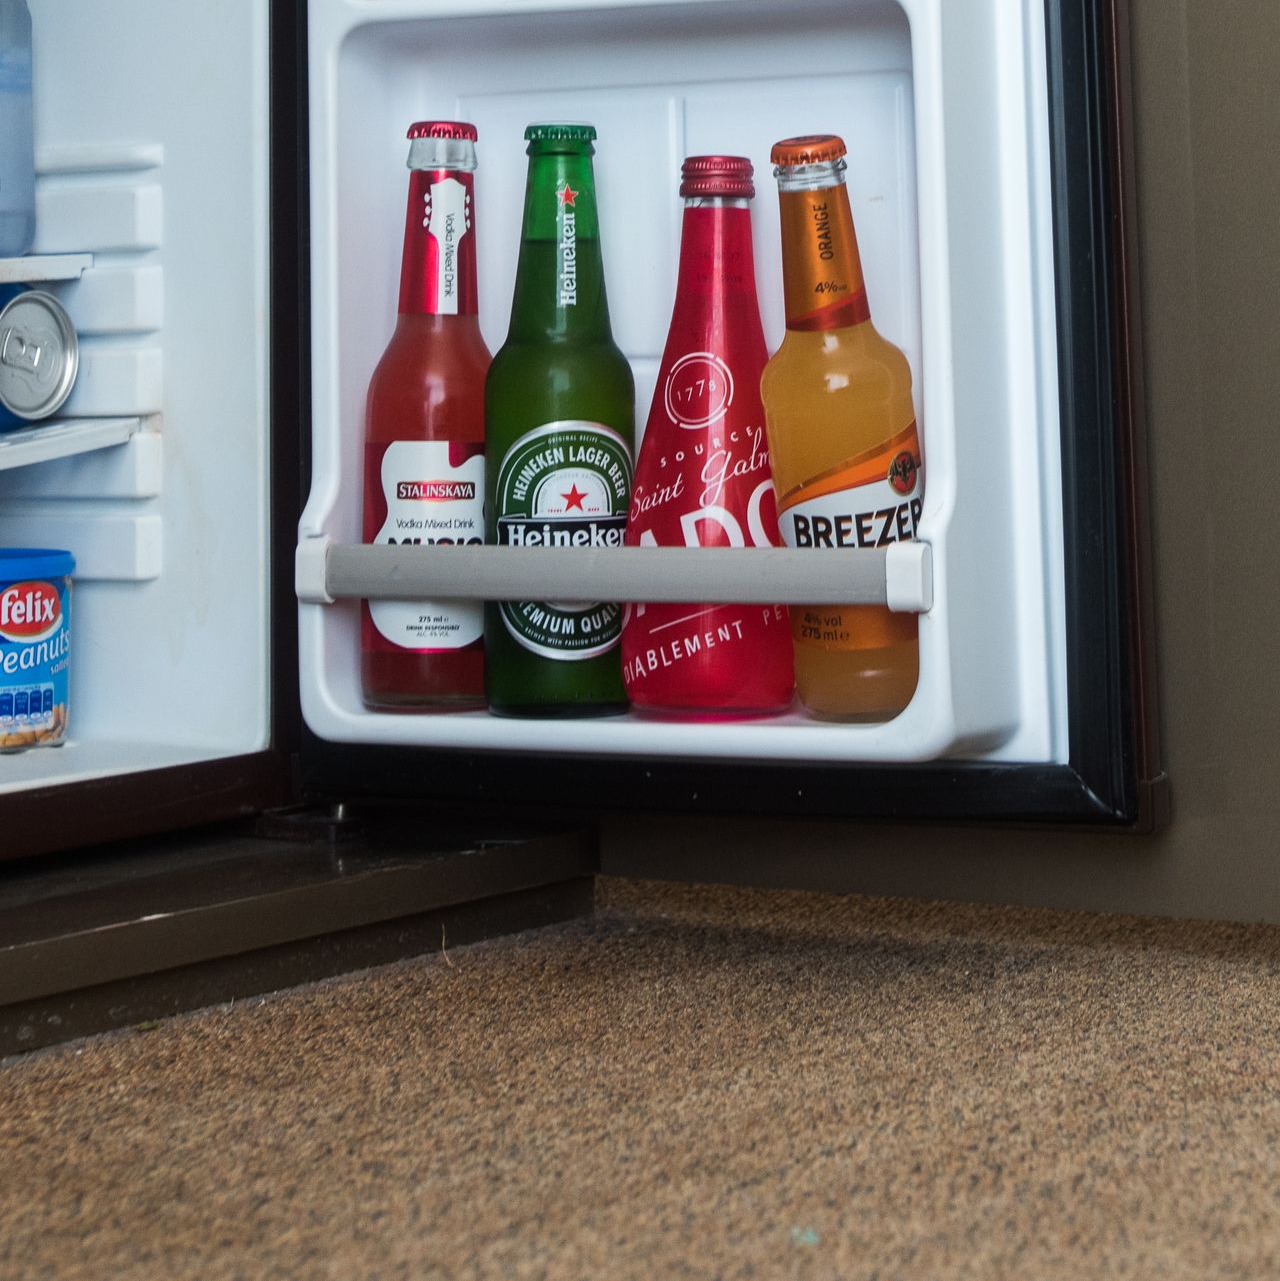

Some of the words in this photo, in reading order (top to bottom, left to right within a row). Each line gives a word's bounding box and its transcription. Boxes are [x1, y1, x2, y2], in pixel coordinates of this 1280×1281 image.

[812, 202, 834, 261] ORANGE
[559, 212, 577, 306] Heineken
[676, 378, 717, 402] 1778
[659, 425, 754, 469] SOURCE
[399, 483, 474, 498] STALINSKAYA
[512, 446, 565, 502] HEINEKEN
[568, 445, 611, 470] LAGER
[607, 462, 626, 499] BEER
[630, 472, 686, 522] Saint
[396, 518, 423, 529] Vodka
[424, 518, 452, 529] Mixed
[453, 518, 475, 529] Drink
[792, 496, 922, 548] BREEZER
[0, 588, 56, 626] felix
[418, 615, 431, 623] 275
[520, 601, 576, 635] EMIUM
[800, 625, 822, 639] 275
